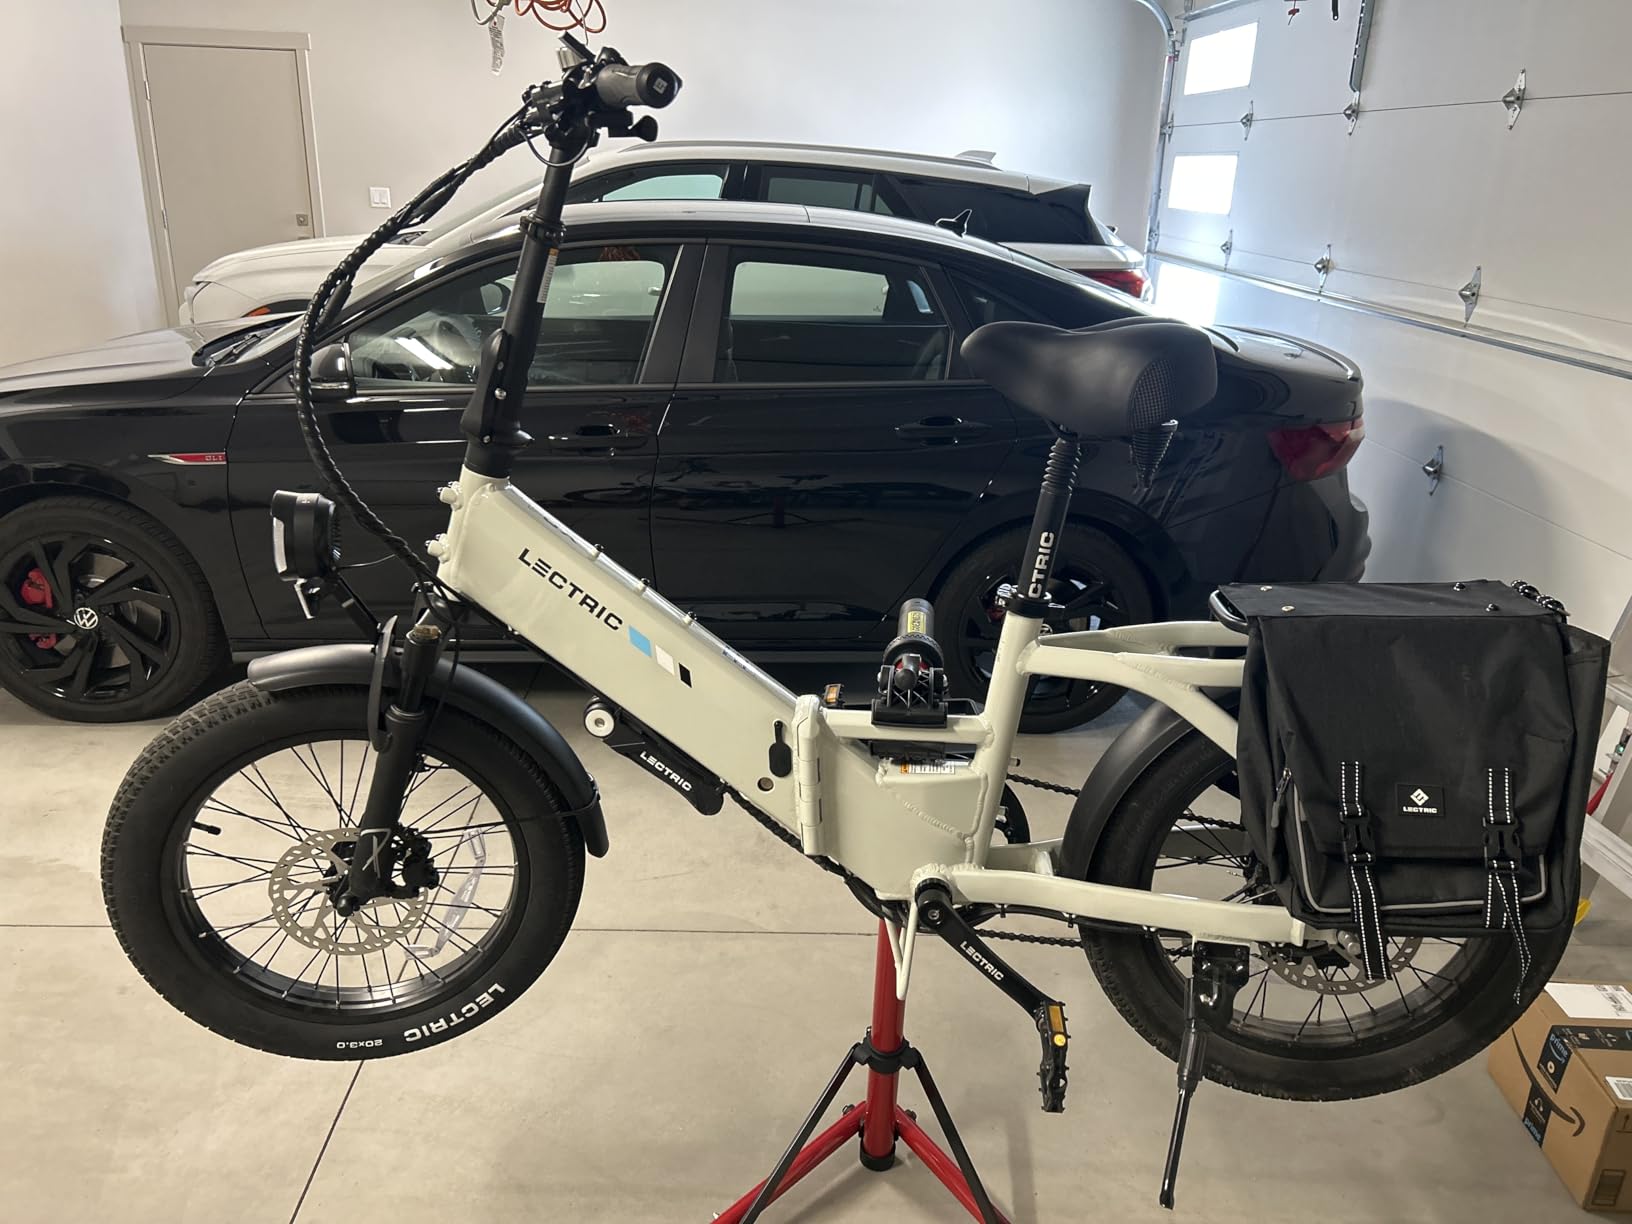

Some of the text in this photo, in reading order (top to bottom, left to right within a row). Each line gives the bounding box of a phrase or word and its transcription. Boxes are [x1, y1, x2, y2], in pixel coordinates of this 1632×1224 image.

[518, 548, 624, 631] LECTRIC
[75, 608, 98, 628] VW
[640, 751, 692, 791] LECTRIC
[1403, 806, 1437, 814] LECTRIC
[960, 941, 1004, 980] LECTRIC
[404, 983, 506, 1042] LECTRIC
[336, 1039, 383, 1049] 20x3.0
[1550, 1033, 1568, 1058] prime
